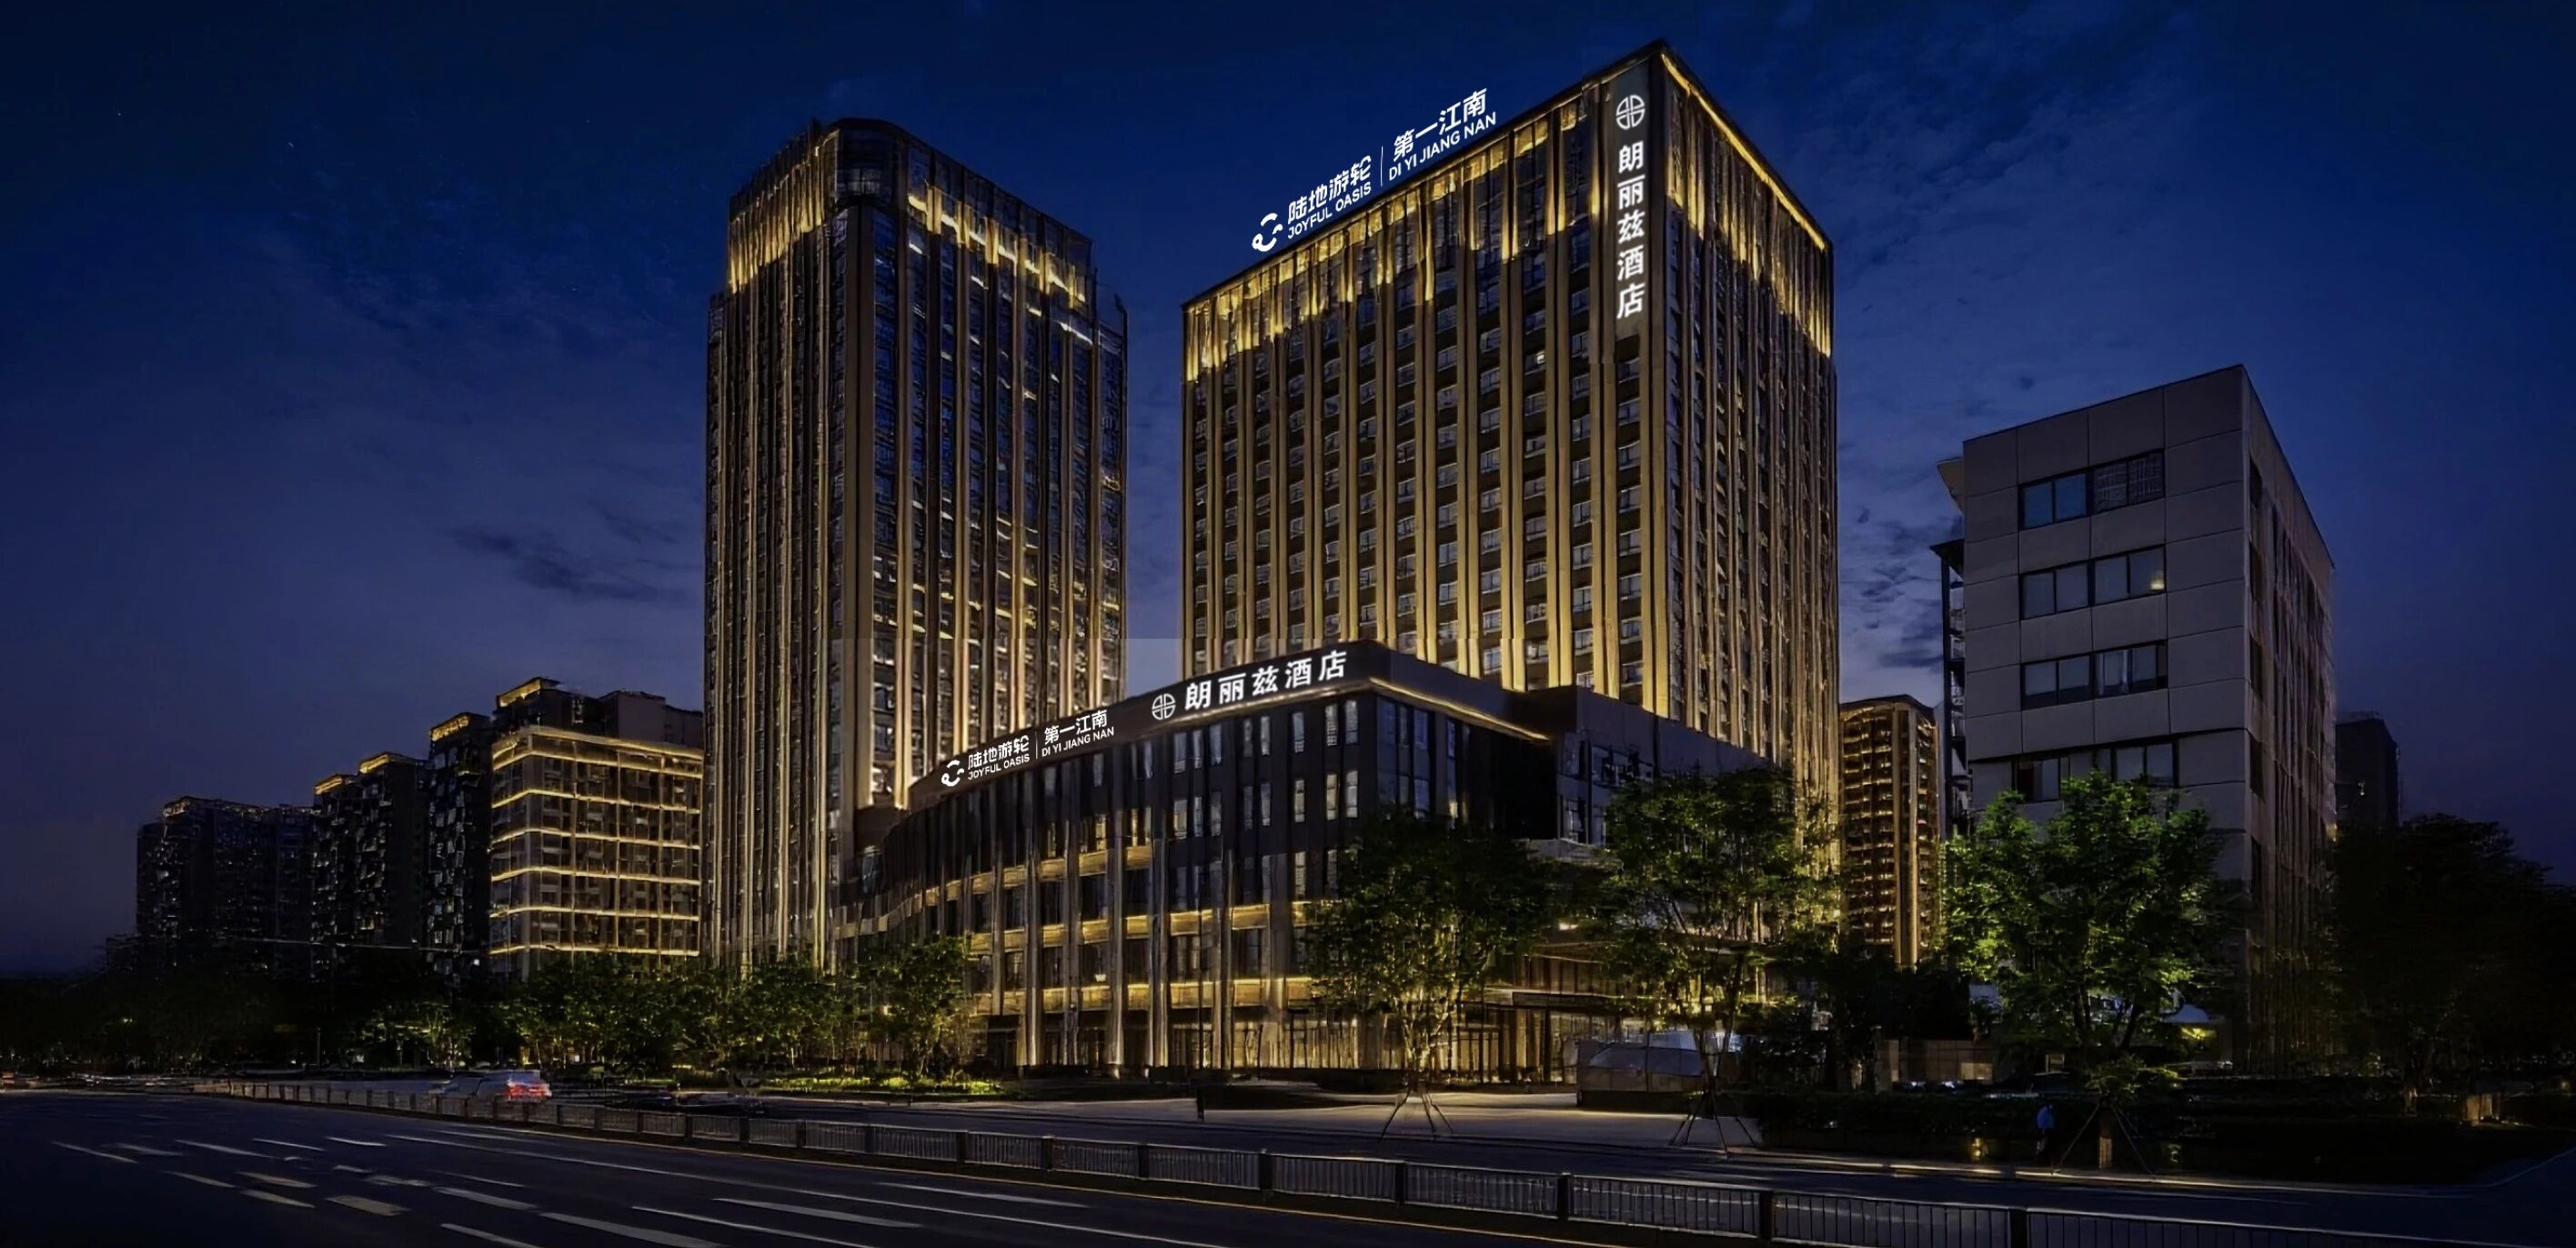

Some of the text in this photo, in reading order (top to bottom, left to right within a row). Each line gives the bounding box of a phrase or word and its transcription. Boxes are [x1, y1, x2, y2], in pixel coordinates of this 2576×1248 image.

[1389, 111, 1496, 181] DI YI JIANG NAN
[1393, 87, 1487, 162] 第一江南
[1287, 182, 1372, 239] JOYFUL OASIS
[1288, 156, 1372, 224] 陆地游轮
[1616, 140, 1646, 319] 朗丽兹酒店
[1184, 649, 1347, 710] 朗丽兹酒店
[967, 734, 1030, 770] 陆地游轮
[1041, 726, 1114, 758] DI YI JIANG NAN
[1044, 709, 1108, 746] 第一江南
[968, 753, 1031, 780] JOYFUL OASIS
